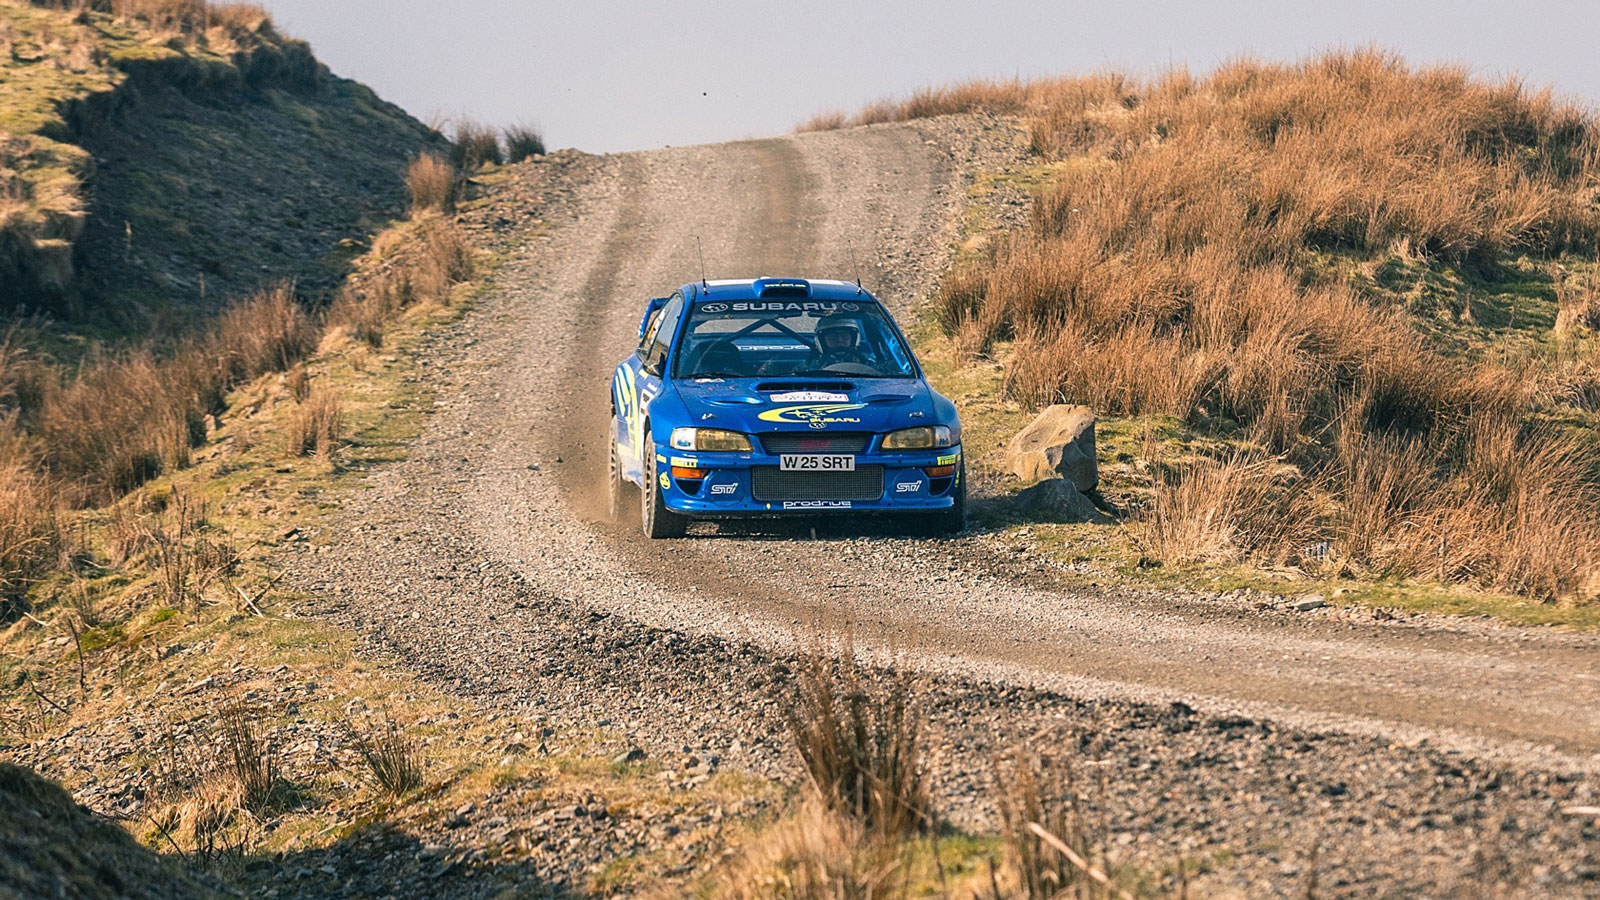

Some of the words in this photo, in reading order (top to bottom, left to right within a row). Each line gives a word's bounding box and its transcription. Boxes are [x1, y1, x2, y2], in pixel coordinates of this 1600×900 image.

[732, 302, 838, 311] SUBARU
[783, 456, 798, 469] W
[800, 456, 819, 469] 25
[822, 456, 853, 469] SRT
[783, 500, 852, 509] prodrive
